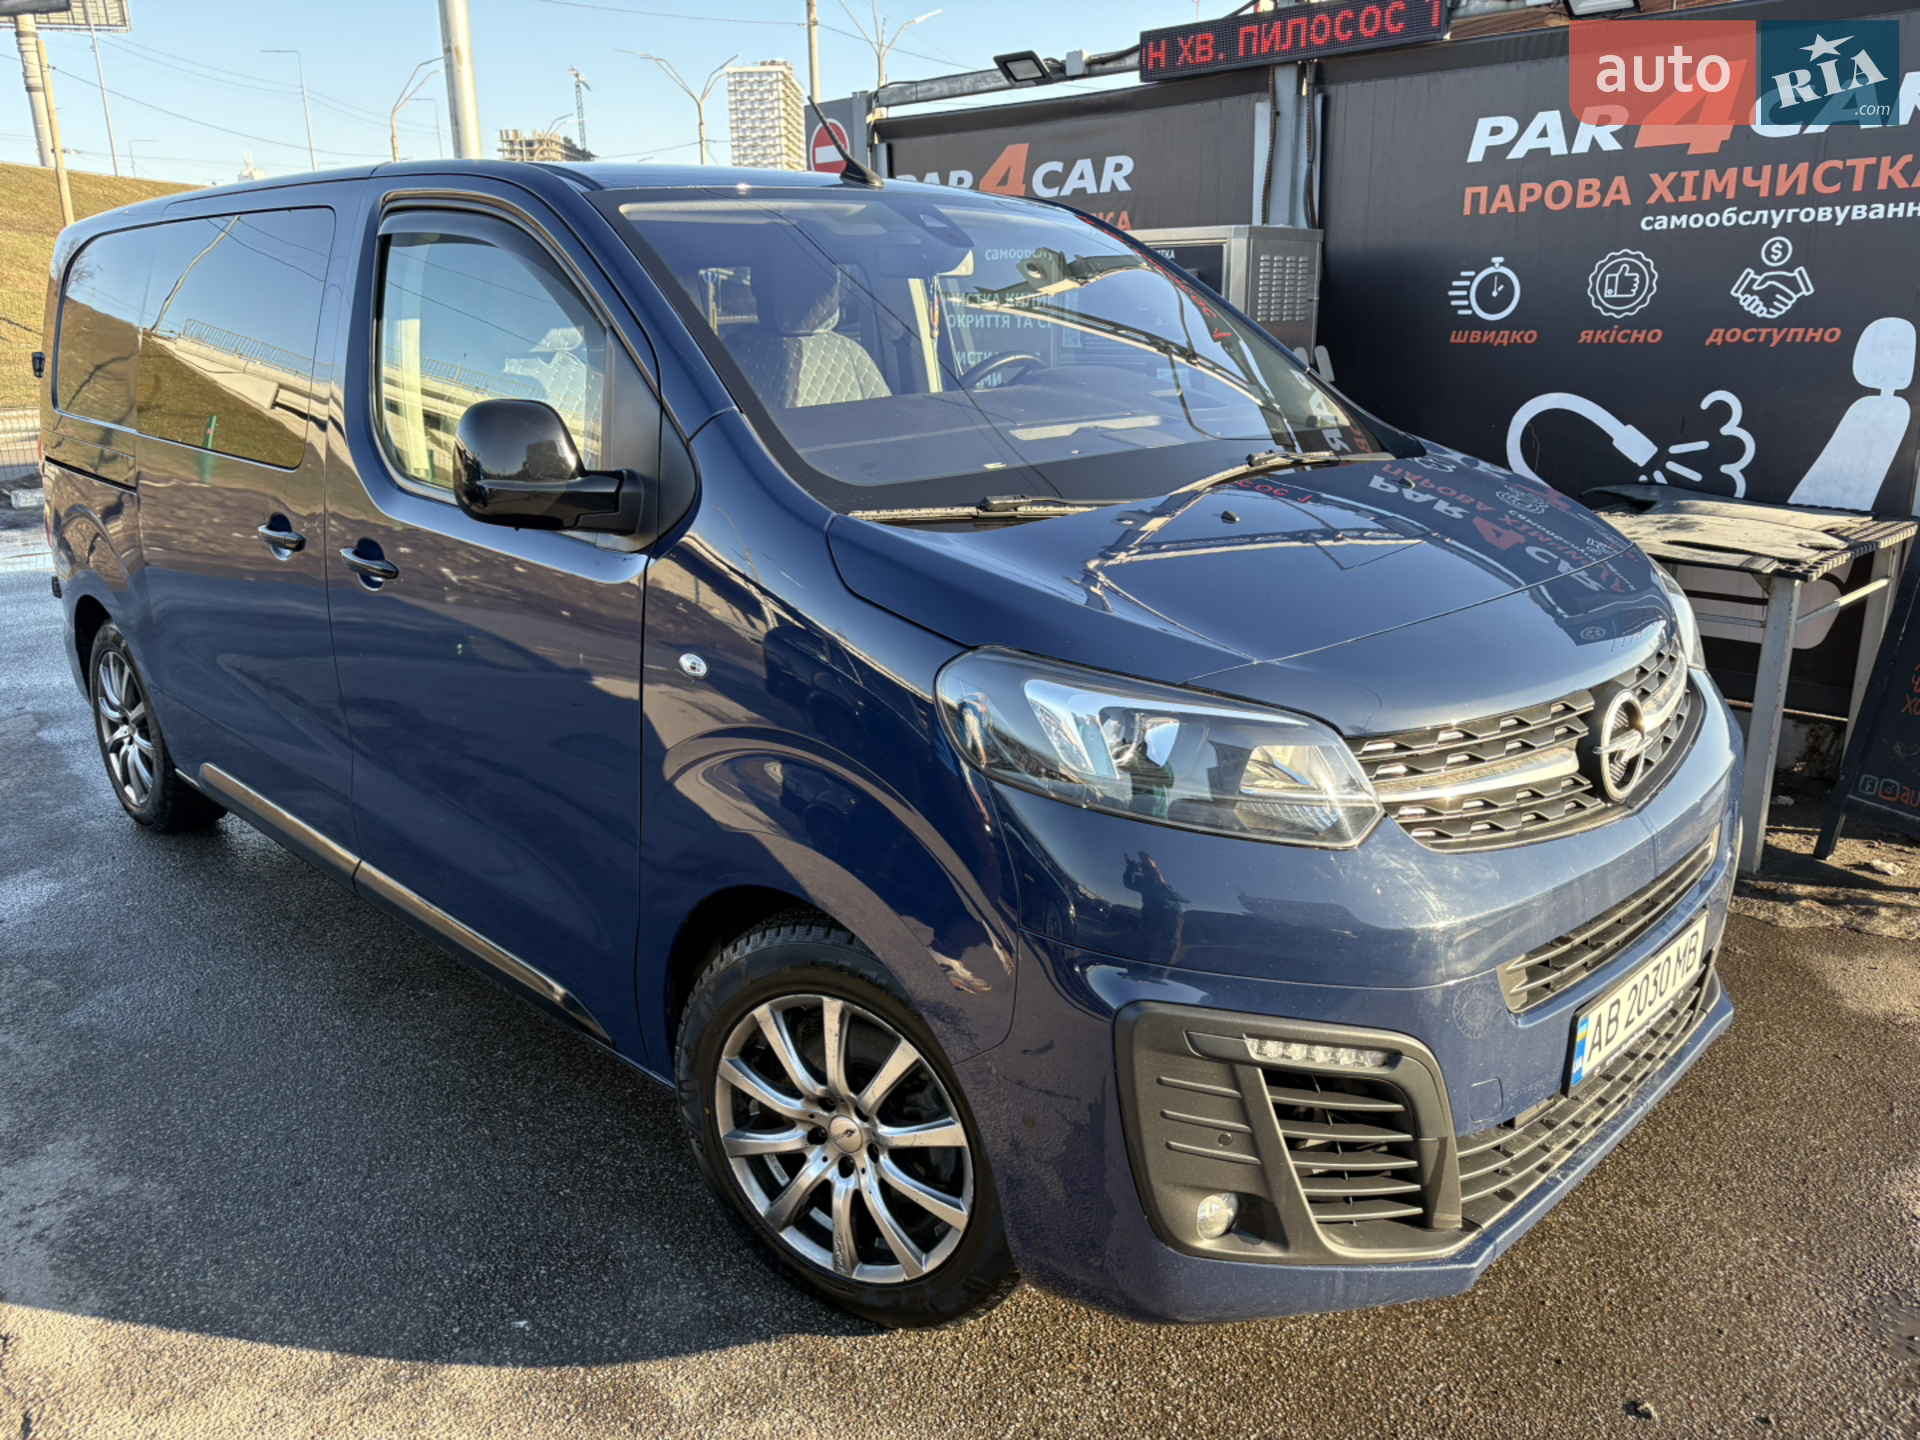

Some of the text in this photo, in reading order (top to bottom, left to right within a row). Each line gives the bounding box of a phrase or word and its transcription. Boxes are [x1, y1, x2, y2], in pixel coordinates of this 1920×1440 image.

[1142, 38, 1166, 70] Н
[1177, 33, 1225, 66] ХВ.
[1238, 2, 1406, 57] ПИЛОСОС
[1463, 153, 1920, 216] ПАРОВА ХІМЧИСТК
[1015, 313, 1035, 329] ТА
[1577, 324, 1664, 344] якісно
[1704, 325, 1842, 347] доступно
[1624, 955, 1672, 1030] 2030
